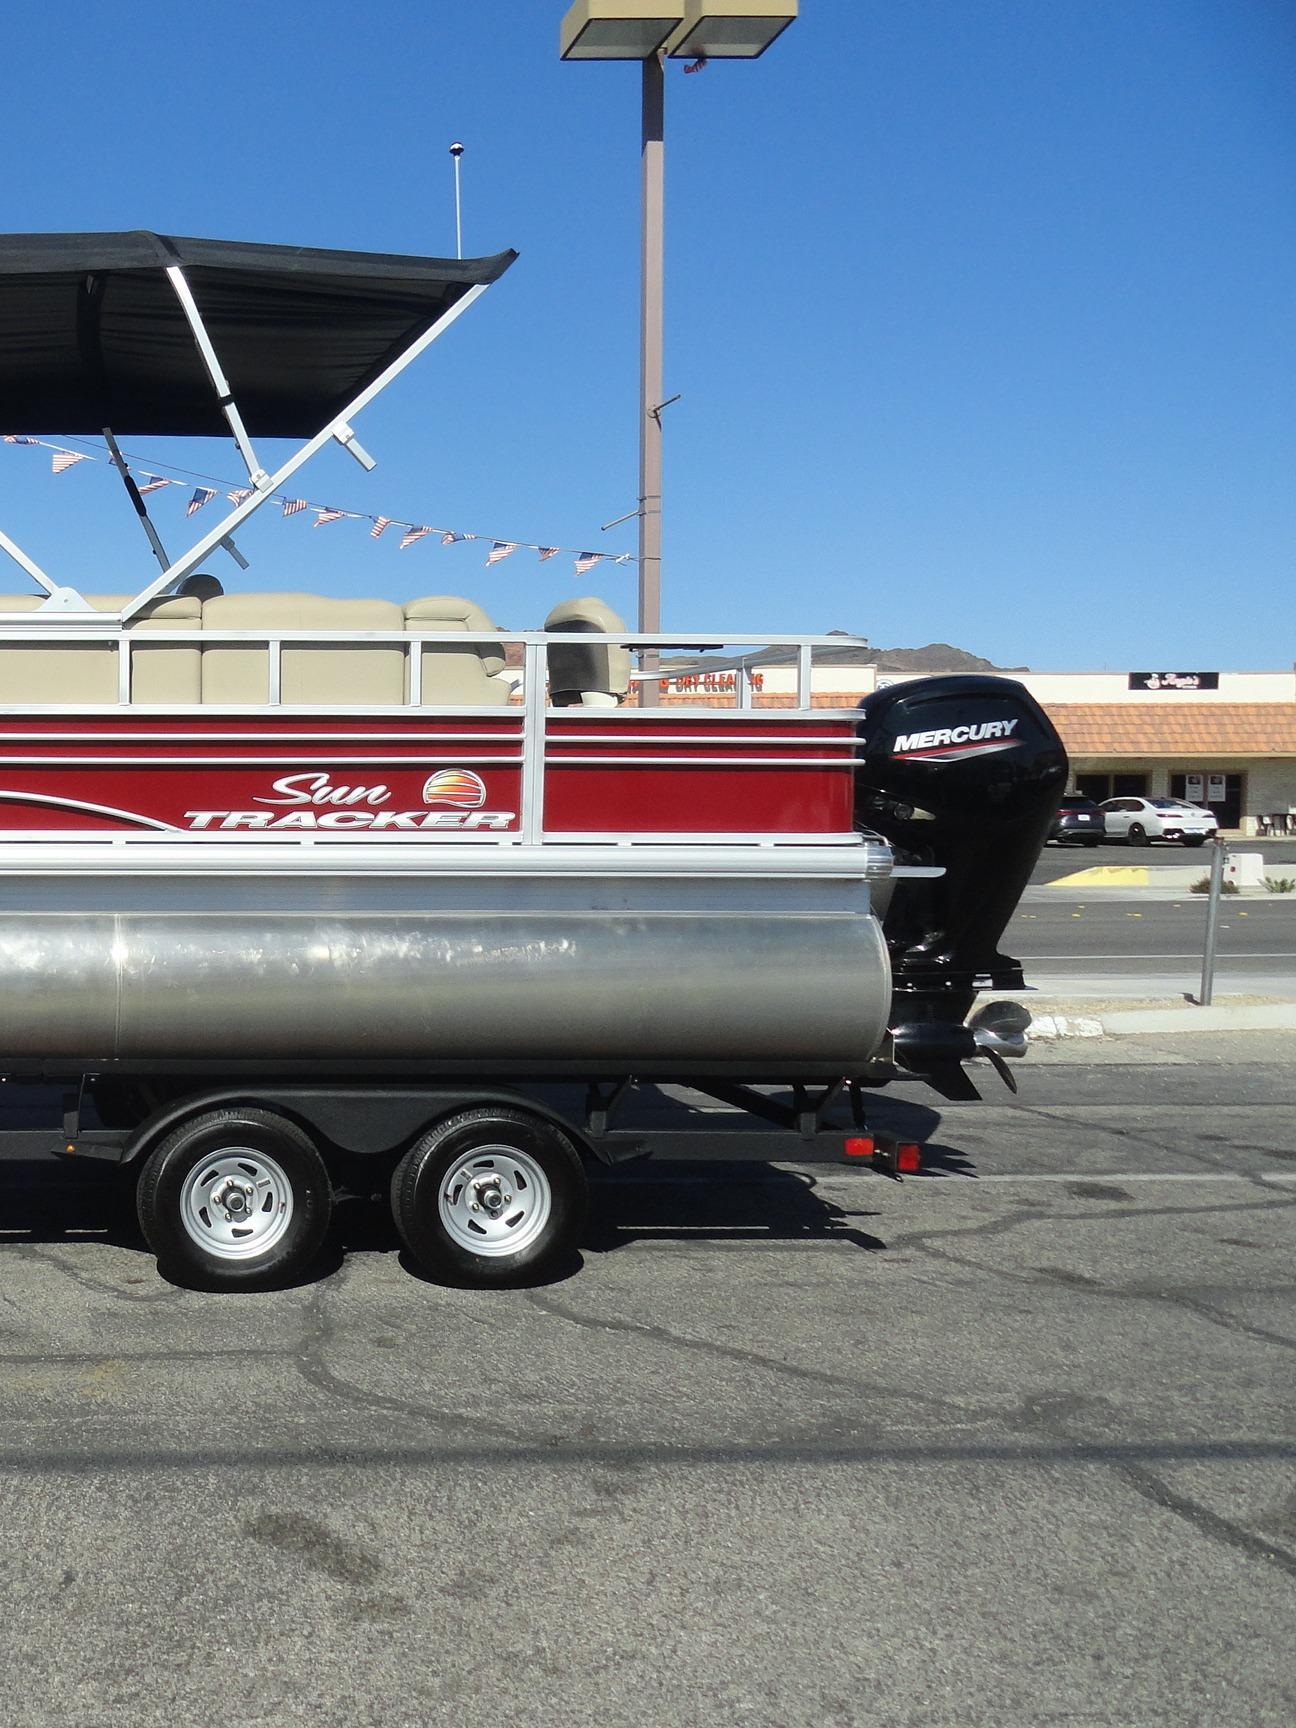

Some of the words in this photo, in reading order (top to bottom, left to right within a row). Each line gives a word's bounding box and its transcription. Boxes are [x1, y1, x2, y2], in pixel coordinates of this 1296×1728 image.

[704, 672, 764, 686] CLEANG
[893, 719, 1019, 752] MERCURY
[252, 772, 391, 806] Sun
[183, 811, 516, 829] TRACKER
